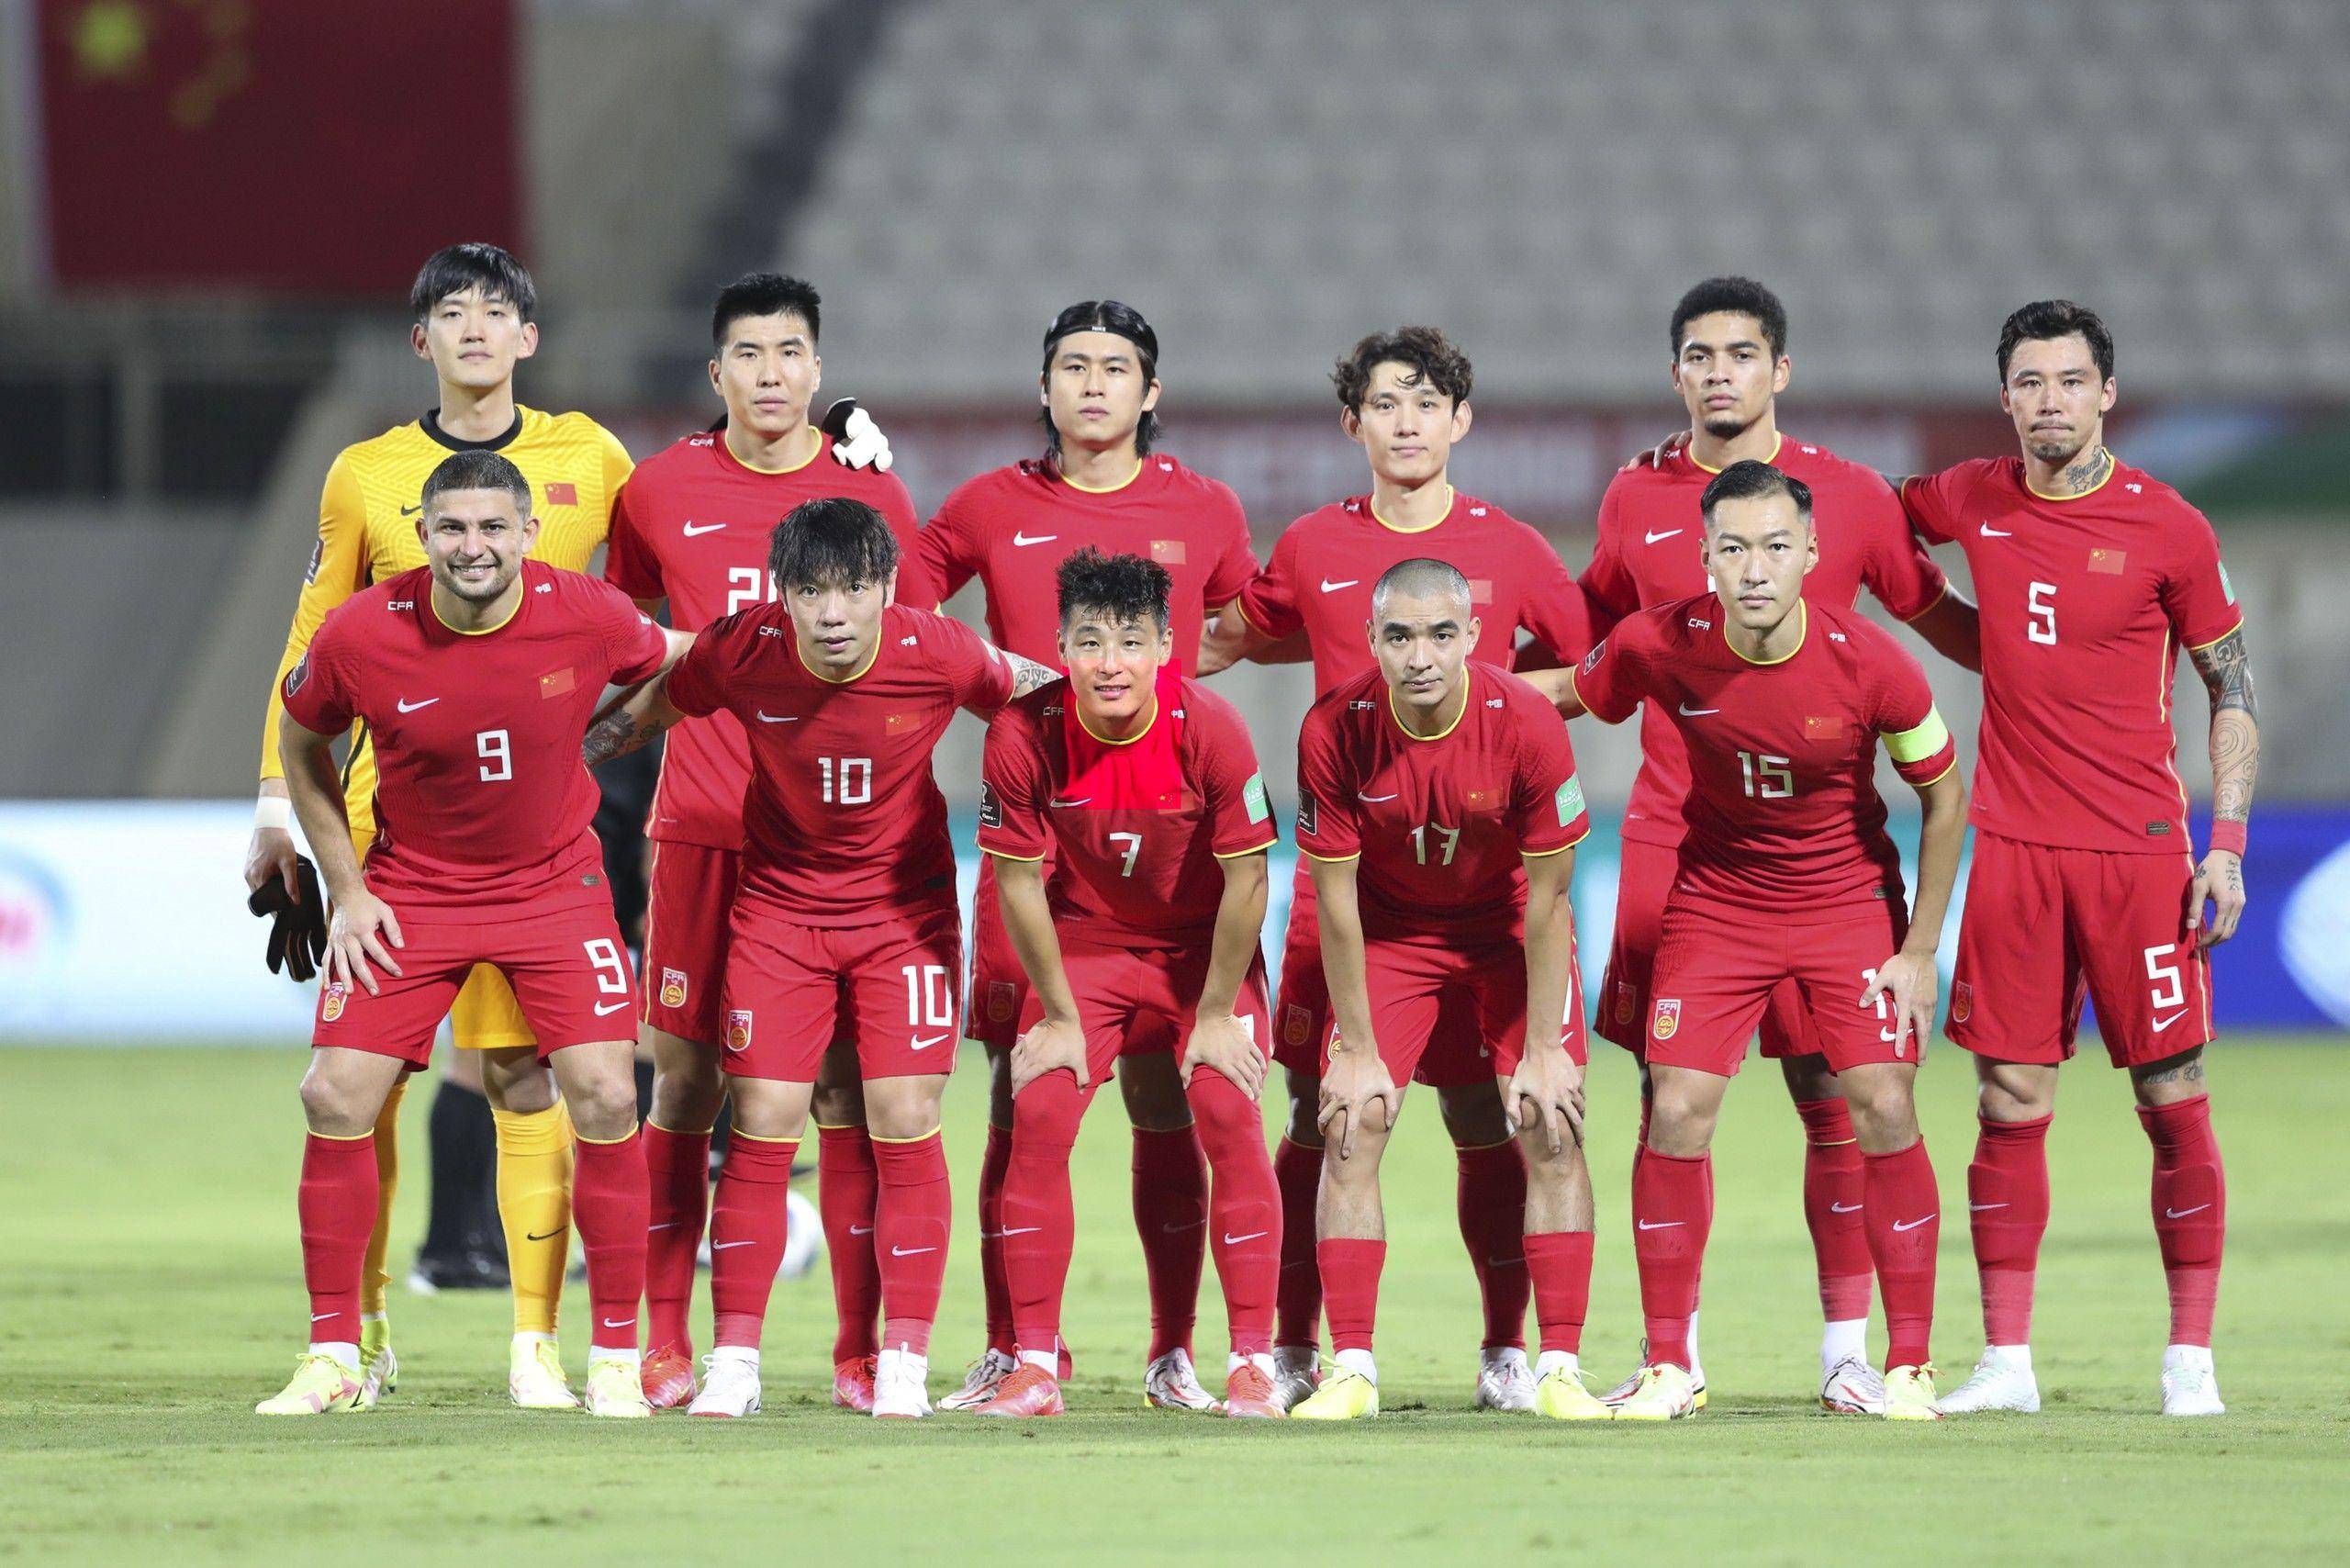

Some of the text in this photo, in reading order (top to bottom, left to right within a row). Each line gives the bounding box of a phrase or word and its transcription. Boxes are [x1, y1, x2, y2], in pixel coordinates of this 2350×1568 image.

[387, 600, 414, 610] CFA
[727, 567, 778, 617] 2
[2028, 581, 2057, 645] 5
[759, 625, 783, 639] CFA
[1688, 618, 1711, 631] CFA
[1348, 700, 1376, 711] CFA
[476, 729, 512, 782] 9
[1737, 751, 1794, 799] 15
[818, 757, 872, 805] 10
[1109, 832, 1142, 878] 7
[1411, 822, 1460, 866] 17
[583, 937, 628, 994] 9
[2143, 943, 2185, 1009] 5
[901, 965, 953, 1027] 10
[1658, 1002, 1677, 1011] CFA
[1861, 968, 1898, 1020] 1
[731, 1014, 750, 1023] CFA
